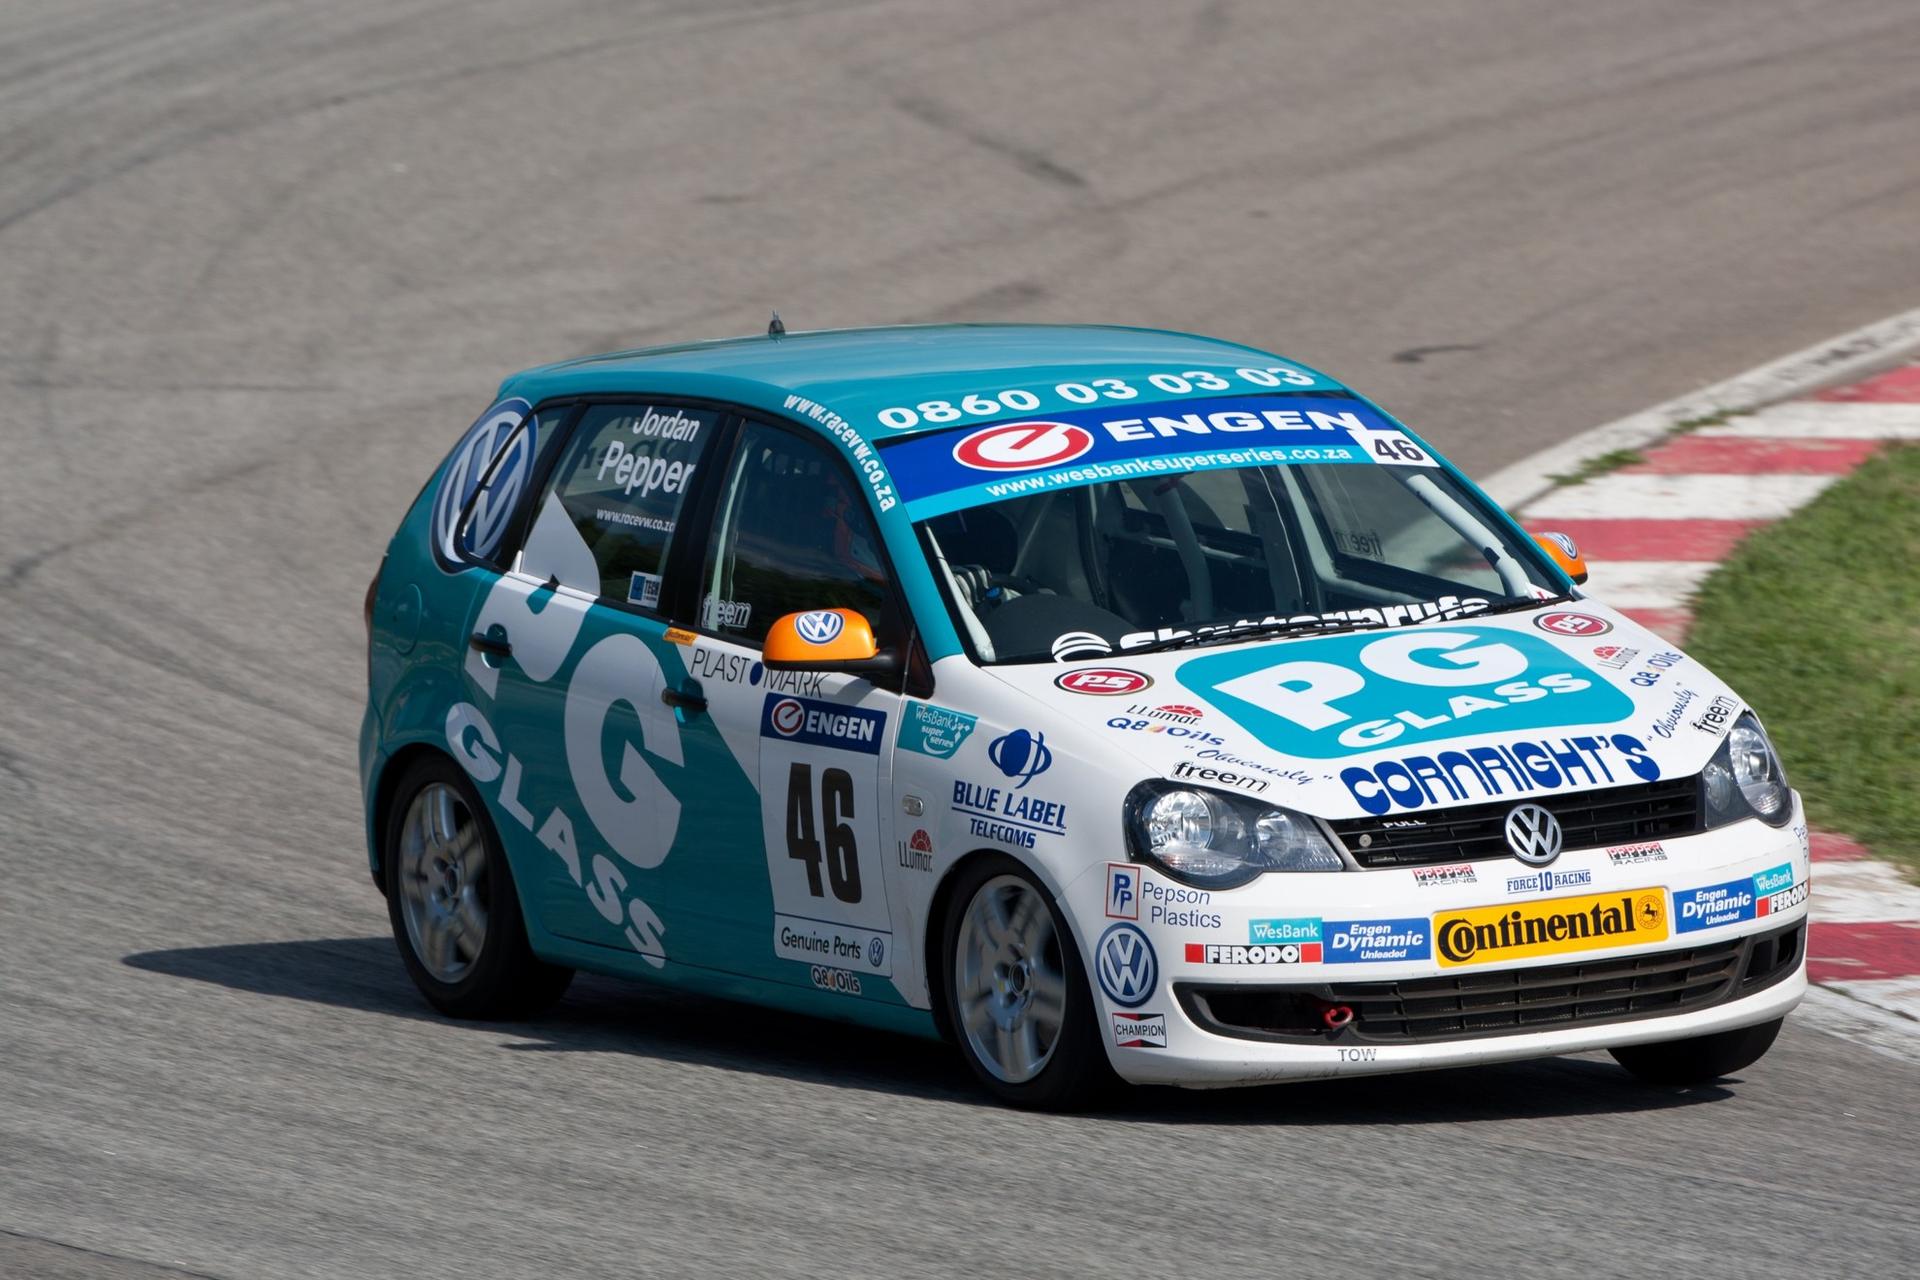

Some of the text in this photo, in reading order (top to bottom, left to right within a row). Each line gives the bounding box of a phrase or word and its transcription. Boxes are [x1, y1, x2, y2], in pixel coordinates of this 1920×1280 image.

[878, 367, 1315, 430] 0860 03 03 03
[632, 406, 700, 442] Jordan
[1102, 410, 1364, 442] ENGEN
[783, 394, 897, 513] www.racevw.co.za
[1374, 438, 1424, 462] 46
[597, 440, 695, 498] Pepper
[986, 447, 1353, 498] www.wesbanksuperseries.co.za
[703, 595, 751, 627] feem
[1551, 614, 1593, 633] PS
[1073, 673, 1136, 691] PS
[1211, 632, 1529, 731] PG
[1126, 704, 1199, 725] LLumar
[1338, 672, 1592, 748] GLASS
[1691, 694, 1737, 736] freem
[806, 710, 875, 743] ENGEN
[1107, 717, 1225, 746] Q8 Oils
[1173, 761, 1267, 792] freem
[953, 780, 1067, 829] BLUE LABEL
[445, 701, 666, 970] GLASS
[786, 762, 862, 904] 46
[899, 841, 932, 872] LLumar
[1142, 881, 1211, 906] Pepson
[1507, 871, 1591, 892] FORCE 10 RACING
[1696, 889, 1727, 902] Engen
[1151, 906, 1222, 929] Plastics
[1682, 893, 1751, 918] Dynamic
[1706, 911, 1739, 926] Unleaded
[781, 926, 861, 960] Genuine Parts
[1254, 926, 1318, 939] WesBank
[1332, 934, 1423, 950] Dynamic
[1350, 924, 1391, 935] Engen
[1438, 898, 1636, 963] Continental
[1206, 946, 1298, 963] FERODO
[1360, 949, 1406, 960] Unleaded
[835, 973, 860, 993] Oils
[1115, 1023, 1165, 1037] CHAMPION
[1338, 1049, 1376, 1062] TOW
